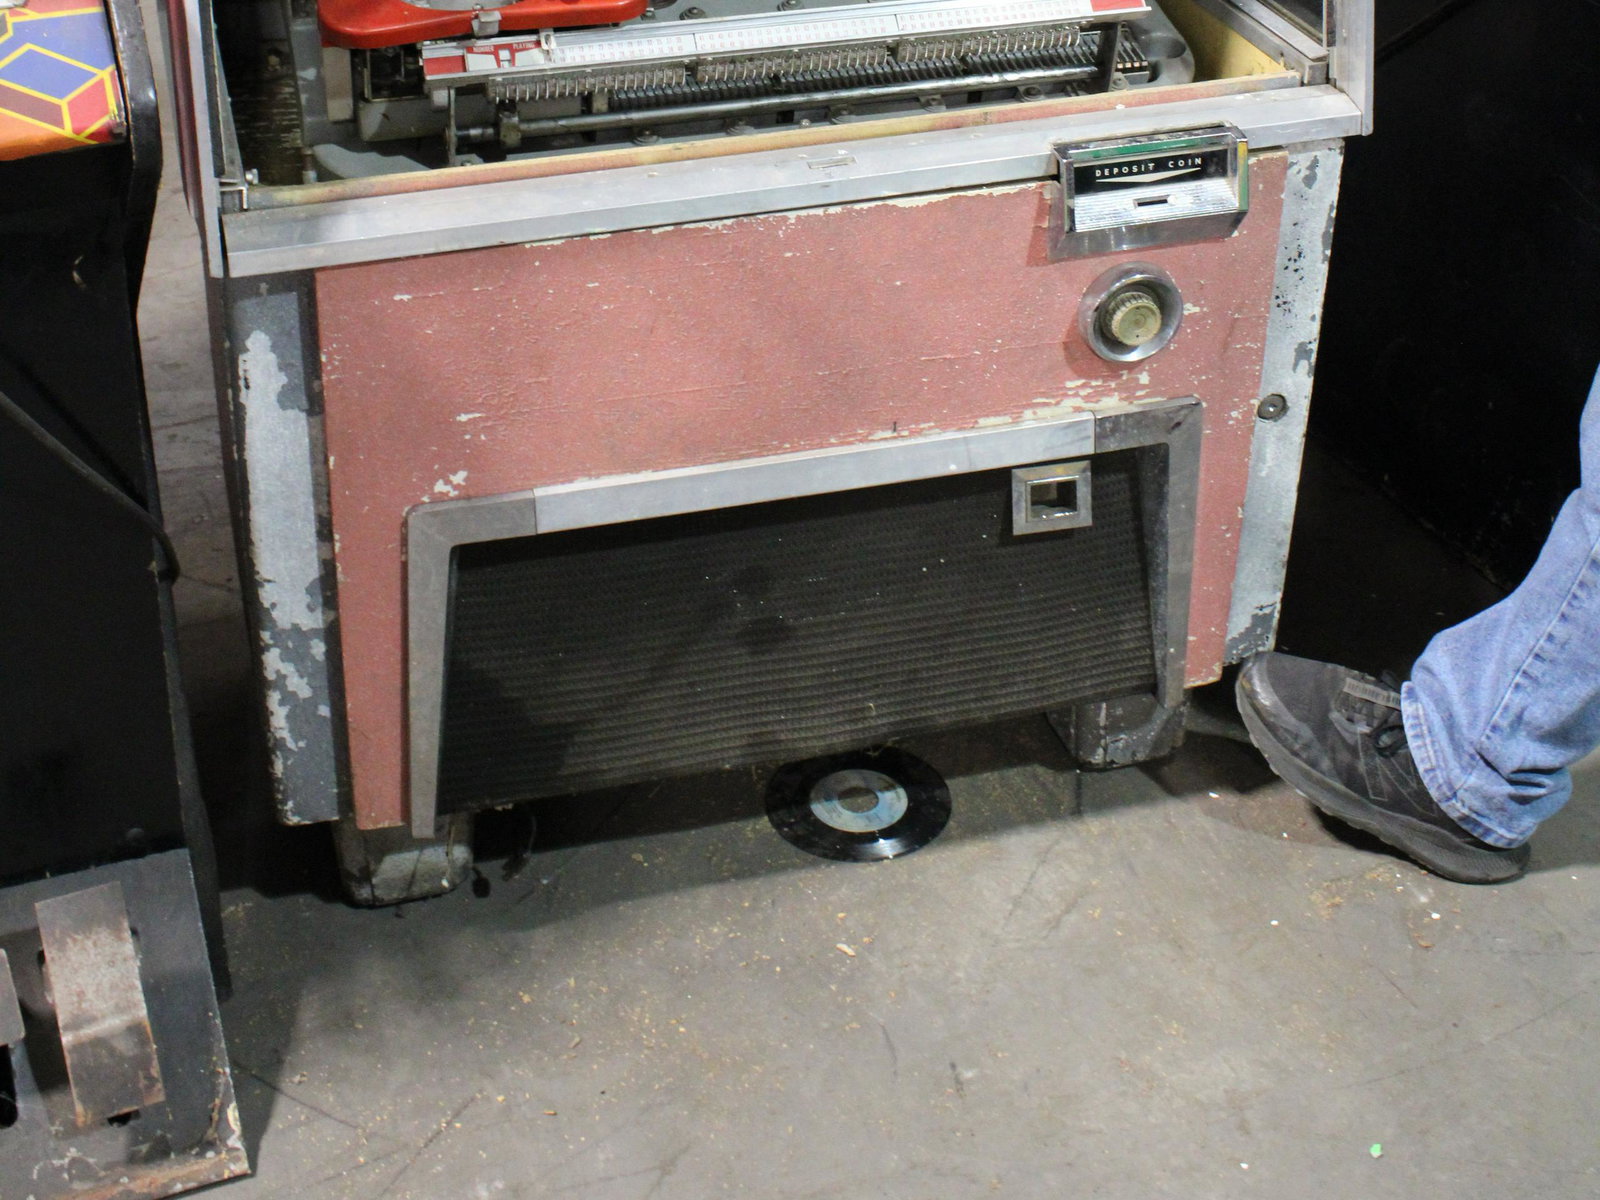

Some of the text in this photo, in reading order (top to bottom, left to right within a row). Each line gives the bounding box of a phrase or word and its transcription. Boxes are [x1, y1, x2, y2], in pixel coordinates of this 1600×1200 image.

[513, 41, 535, 49] PLAYING
[1095, 157, 1202, 177] DEPOSIT COIN
